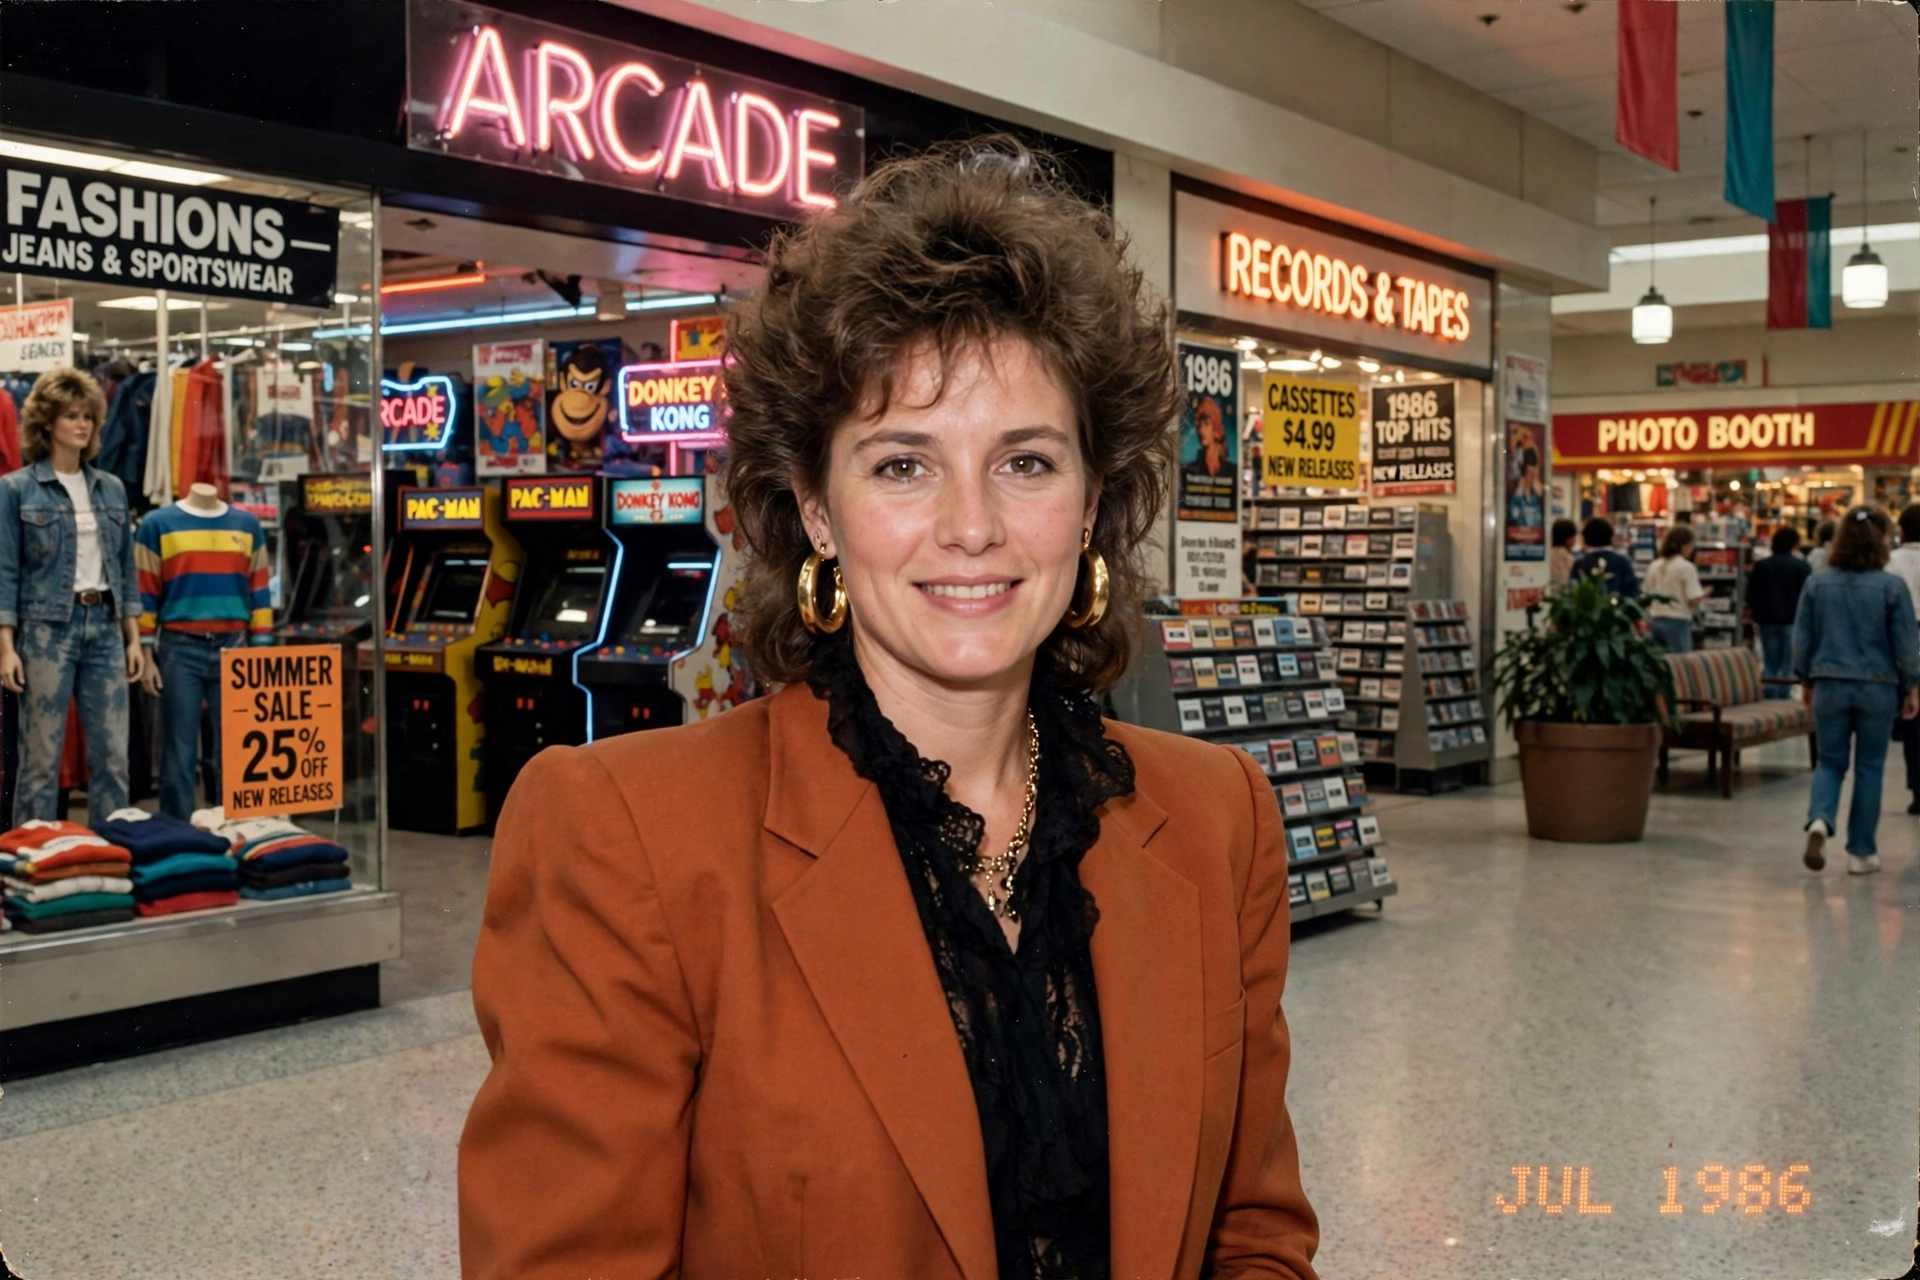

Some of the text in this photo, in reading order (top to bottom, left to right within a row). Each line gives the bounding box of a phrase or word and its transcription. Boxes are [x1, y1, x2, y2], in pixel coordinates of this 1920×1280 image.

[440, 24, 842, 209] ARCADE
[6, 168, 286, 260] FASHIONS
[2, 232, 294, 295] JEANS & SPORTSWEAR
[1228, 232, 1470, 342] RECORDS & TAPES
[628, 375, 717, 407] DONKEY
[1184, 353, 1233, 398] 1986
[380, 395, 446, 428] RCADE
[1268, 383, 1356, 419] CASSETTES
[1386, 389, 1438, 420] 1986
[650, 404, 710, 432] KONG
[1283, 417, 1336, 452] $4.99
[1375, 416, 1452, 444] TOP HITS
[1598, 411, 1815, 453] PHOTO BOOTH
[1268, 455, 1355, 481] NEW RELEASES
[1399, 461, 1454, 480] RELEASES
[406, 496, 481, 520] PAC-MAN
[511, 485, 589, 509] PAC-MAN
[616, 490, 700, 511] DONKEY KONG
[231, 655, 333, 690] SUMMER
[254, 690, 313, 723] SALE
[242, 726, 329, 784] 25% OFF
[233, 782, 334, 810] NEW RELEASES
